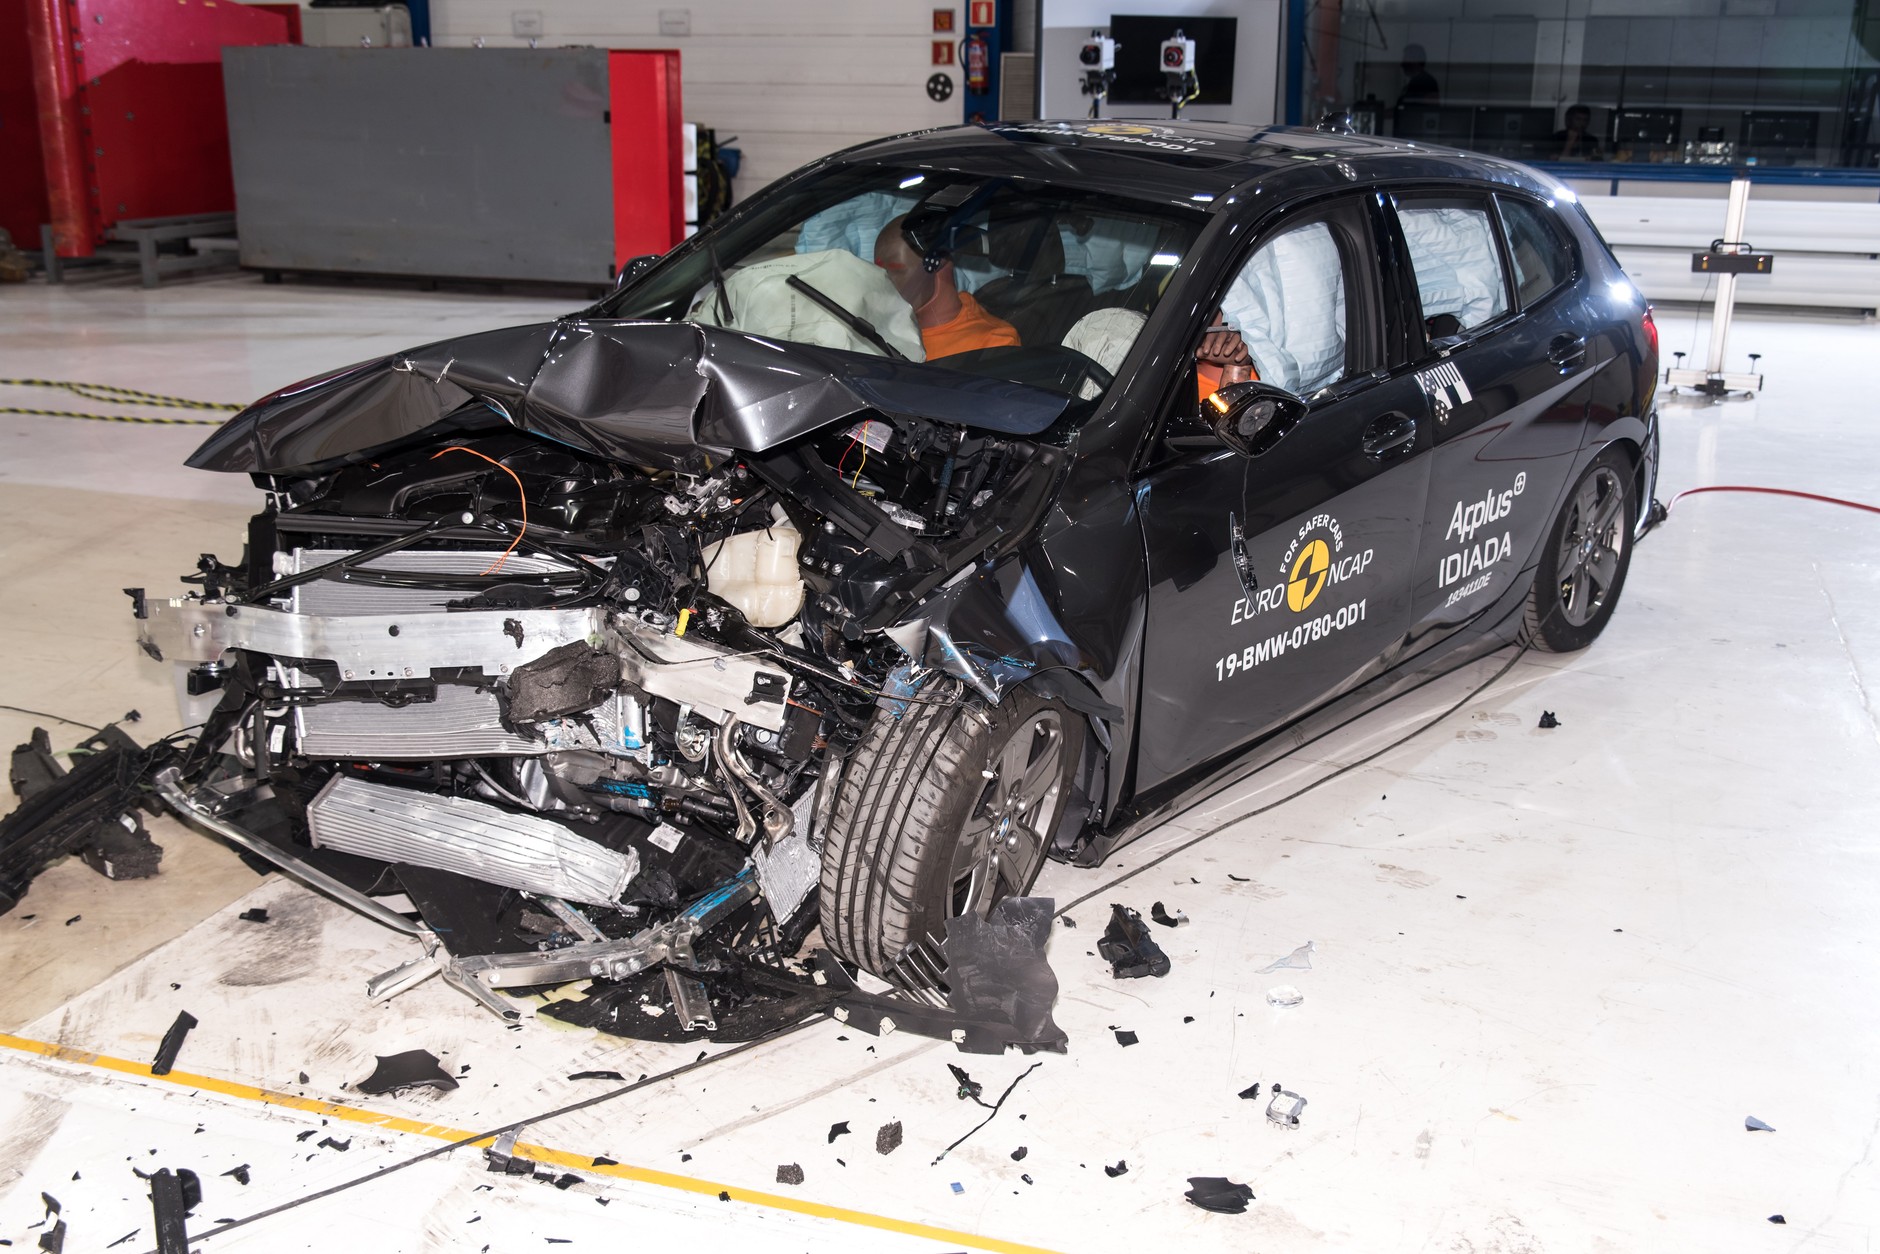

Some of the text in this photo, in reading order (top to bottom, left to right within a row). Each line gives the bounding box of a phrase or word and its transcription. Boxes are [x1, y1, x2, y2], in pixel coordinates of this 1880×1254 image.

[1142, 132, 1216, 146] NCAP
[1279, 514, 1344, 574] FOR SAFER CARS
[1439, 531, 1512, 589] IDIADA
[1231, 549, 1374, 626] EURO NCAP
[1444, 571, 1493, 609] 193411DE
